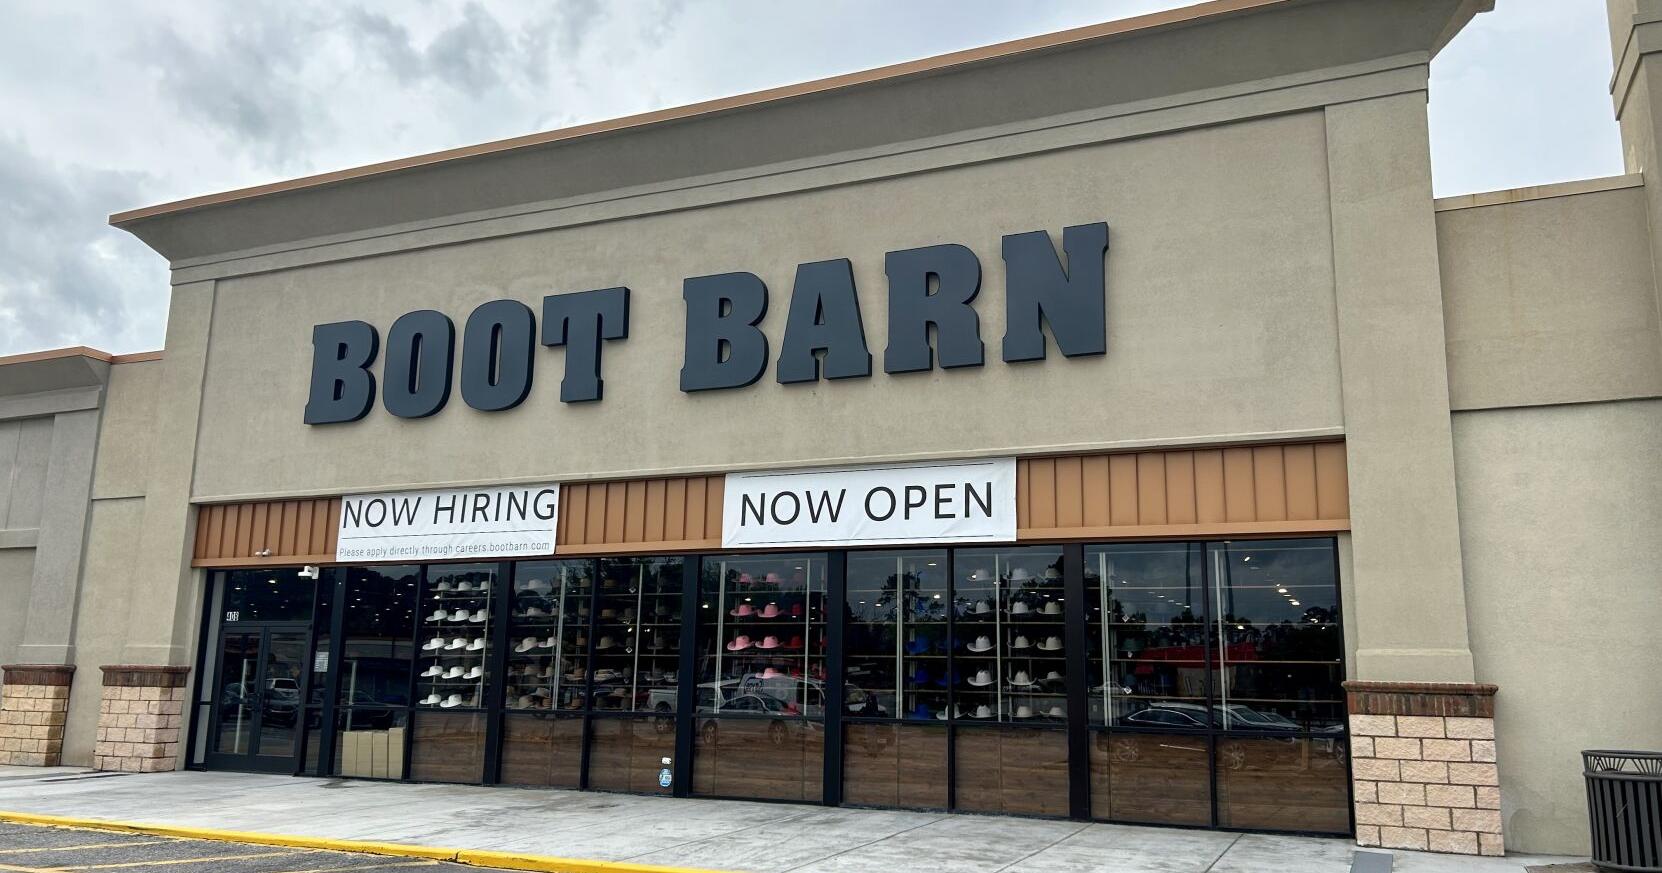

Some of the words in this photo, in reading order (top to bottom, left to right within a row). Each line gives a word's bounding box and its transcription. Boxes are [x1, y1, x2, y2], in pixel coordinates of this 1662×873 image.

[304, 286, 630, 426] BOOT
[680, 221, 1110, 393] BARN
[343, 496, 422, 529] NOW
[433, 488, 555, 525] HIRING
[741, 488, 847, 527] NOW
[864, 481, 992, 522] OPEN
[340, 547, 364, 557] Please
[366, 545, 388, 557] apply
[389, 545, 419, 556] directly
[422, 543, 453, 556] through
[455, 541, 550, 553] careers.bootbarn.com
